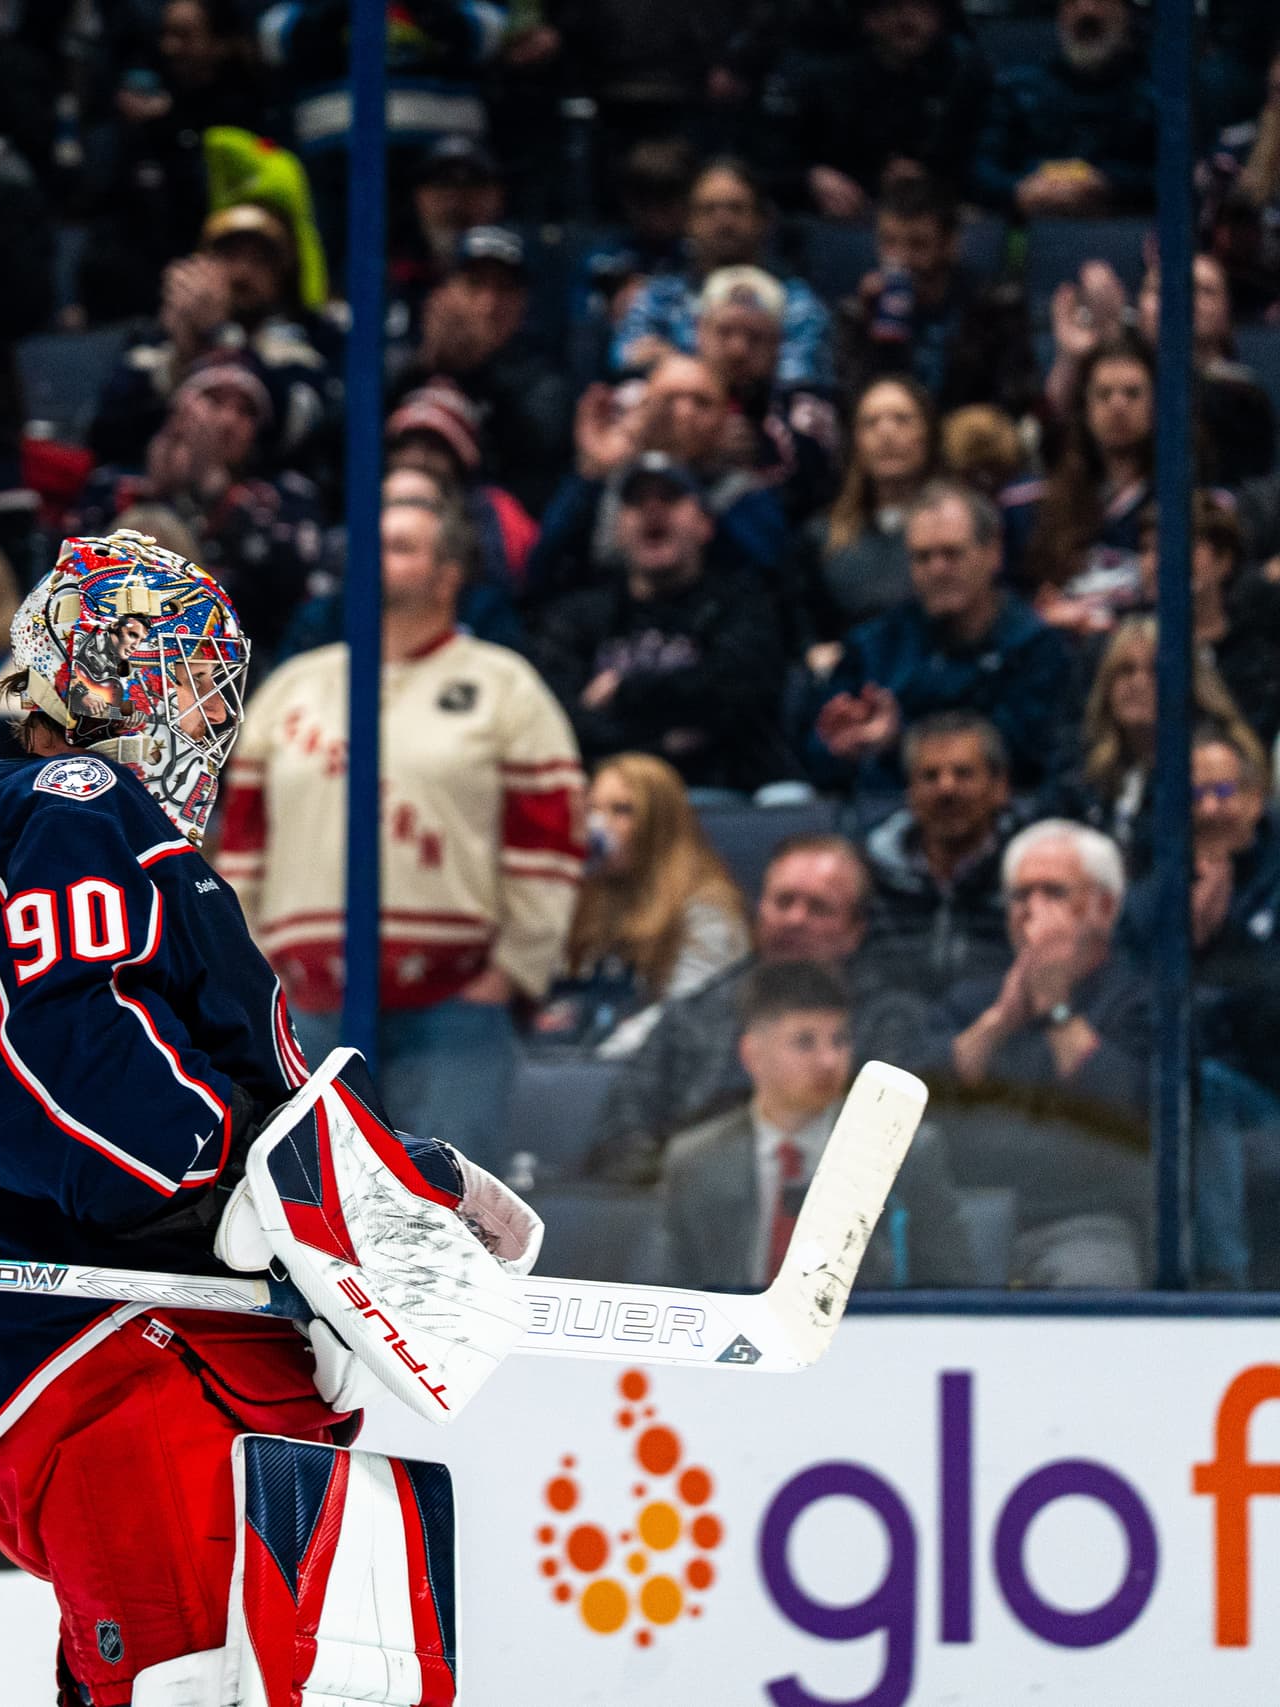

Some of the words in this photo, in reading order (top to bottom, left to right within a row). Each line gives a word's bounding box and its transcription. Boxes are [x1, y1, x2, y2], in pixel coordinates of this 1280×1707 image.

[2, 875, 131, 988] 90
[336, 1276, 451, 1411] TRUE
[523, 1293, 706, 1348] AUER
